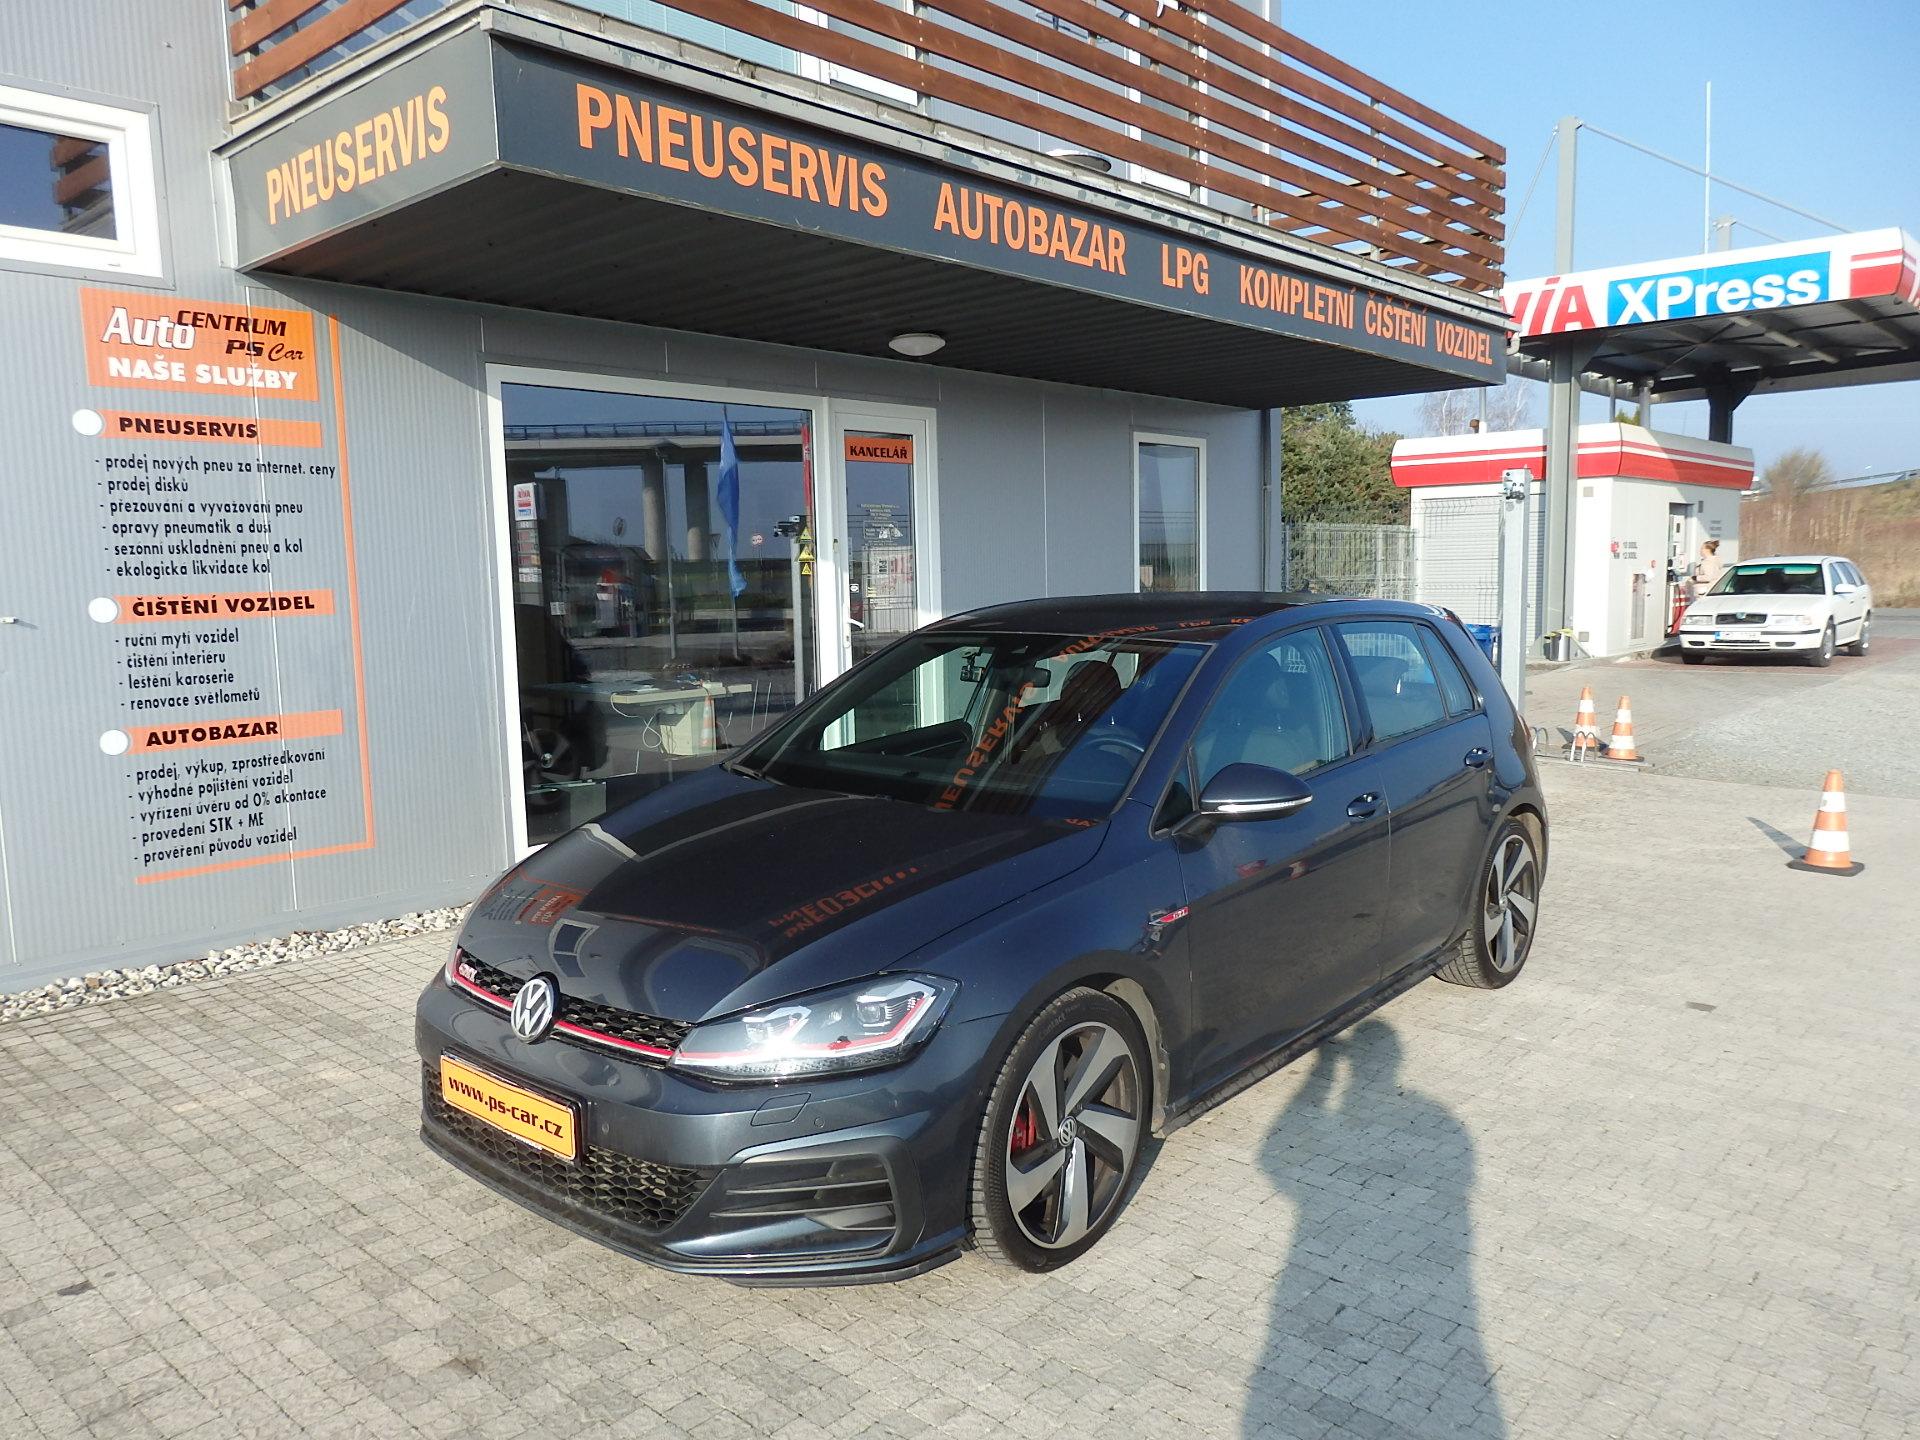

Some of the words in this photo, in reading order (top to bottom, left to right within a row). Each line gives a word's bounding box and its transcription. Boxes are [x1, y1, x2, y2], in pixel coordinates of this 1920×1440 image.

[265, 86, 450, 225] PNEUSERVIS
[576, 84, 888, 217] PNEUSERVIS
[934, 182, 1127, 276] AUTOBAZAR
[1161, 244, 1208, 294] LPG
[1239, 265, 1357, 329] KOMPLETNÍ
[1364, 290, 1428, 347] ČIŠTĚNÍ
[1435, 319, 1493, 365] VOZIDEL
[1616, 268, 1821, 325] XPress
[101, 306, 196, 350] Auto
[177, 310, 287, 337] CENTRUM
[225, 339, 265, 357] PS
[268, 343, 305, 361] Car
[108, 354, 187, 382] NAŠE
[195, 361, 298, 390] SLUŽBY
[119, 417, 258, 438] PNEUSERVIS
[850, 445, 907, 459] KANCELÁŘ
[105, 453, 148, 473] prodej
[152, 455, 199, 474] nových
[203, 461, 233, 474] pneu
[237, 462, 252, 472] za
[309, 465, 335, 479] ceny
[108, 475, 150, 495] prodej
[188, 502, 195, 512] a
[275, 503, 303, 516] pneu
[112, 523, 159, 538] opravy
[164, 518, 231, 538] pneumatik
[236, 523, 243, 533] a
[241, 543, 269, 557] pneu
[273, 543, 281, 553] a
[285, 538, 303, 553] kol
[116, 560, 188, 579] ekologická
[192, 559, 248, 575] likvidace
[252, 558, 271, 573] kol
[132, 594, 218, 617] ČIŠTĚNÍ
[225, 596, 315, 613] VOZIDEL
[195, 627, 239, 643] vozidel
[172, 649, 226, 666] interiéru
[175, 668, 234, 686] karoserie
[130, 696, 190, 710] renovace
[145, 721, 279, 747] AUTOBAZAR
[138, 782, 193, 804] výhodné
[252, 768, 294, 787] vozidel
[235, 793, 249, 808] od
[253, 791, 270, 807] 0%
[274, 788, 327, 804] akontace
[142, 821, 205, 847] provedení
[209, 816, 233, 833] STK
[248, 811, 264, 828] ME
[209, 832, 252, 856] původu
[256, 826, 297, 845] vozidel
[448, 1076, 564, 1139] www.ps-car.cz
